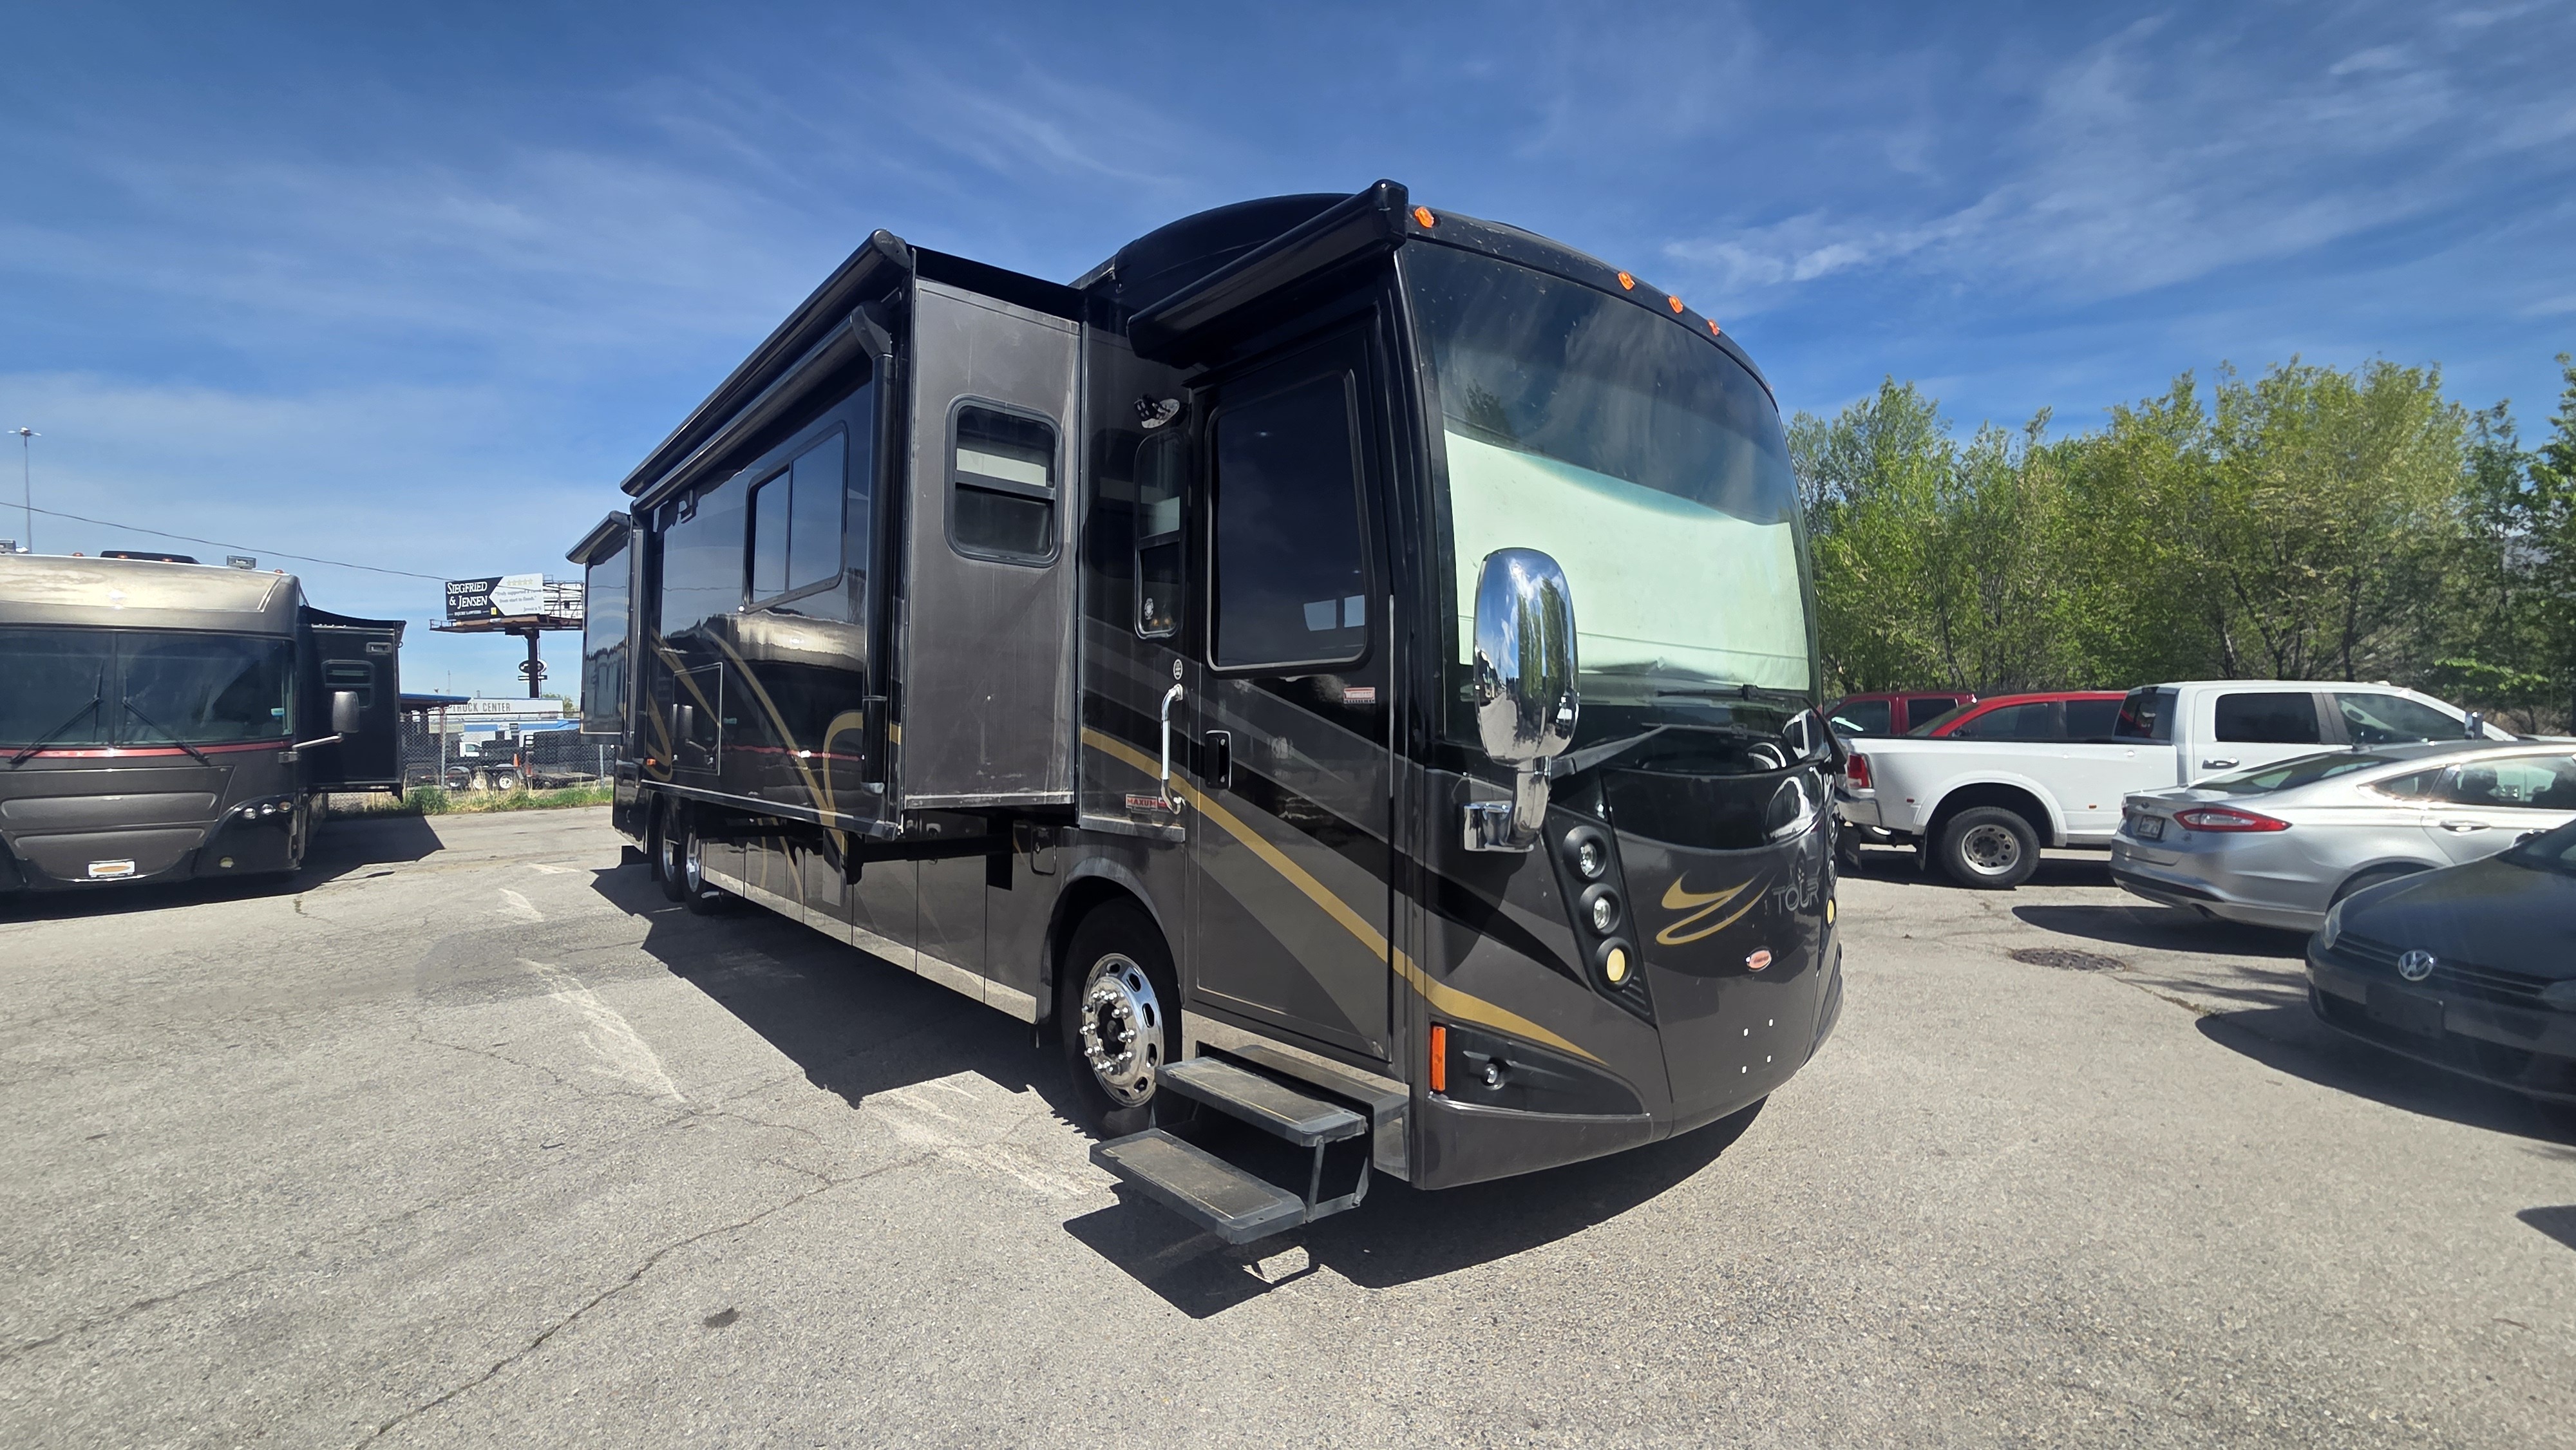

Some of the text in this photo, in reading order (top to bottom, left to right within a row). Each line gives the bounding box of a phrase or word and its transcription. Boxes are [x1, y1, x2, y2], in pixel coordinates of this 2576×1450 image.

[447, 581, 488, 594] SIEGFRIED
[449, 595, 488, 610] & JENSEN
[482, 702, 511, 712] CENTER
[1127, 796, 1156, 807] MAXUM
